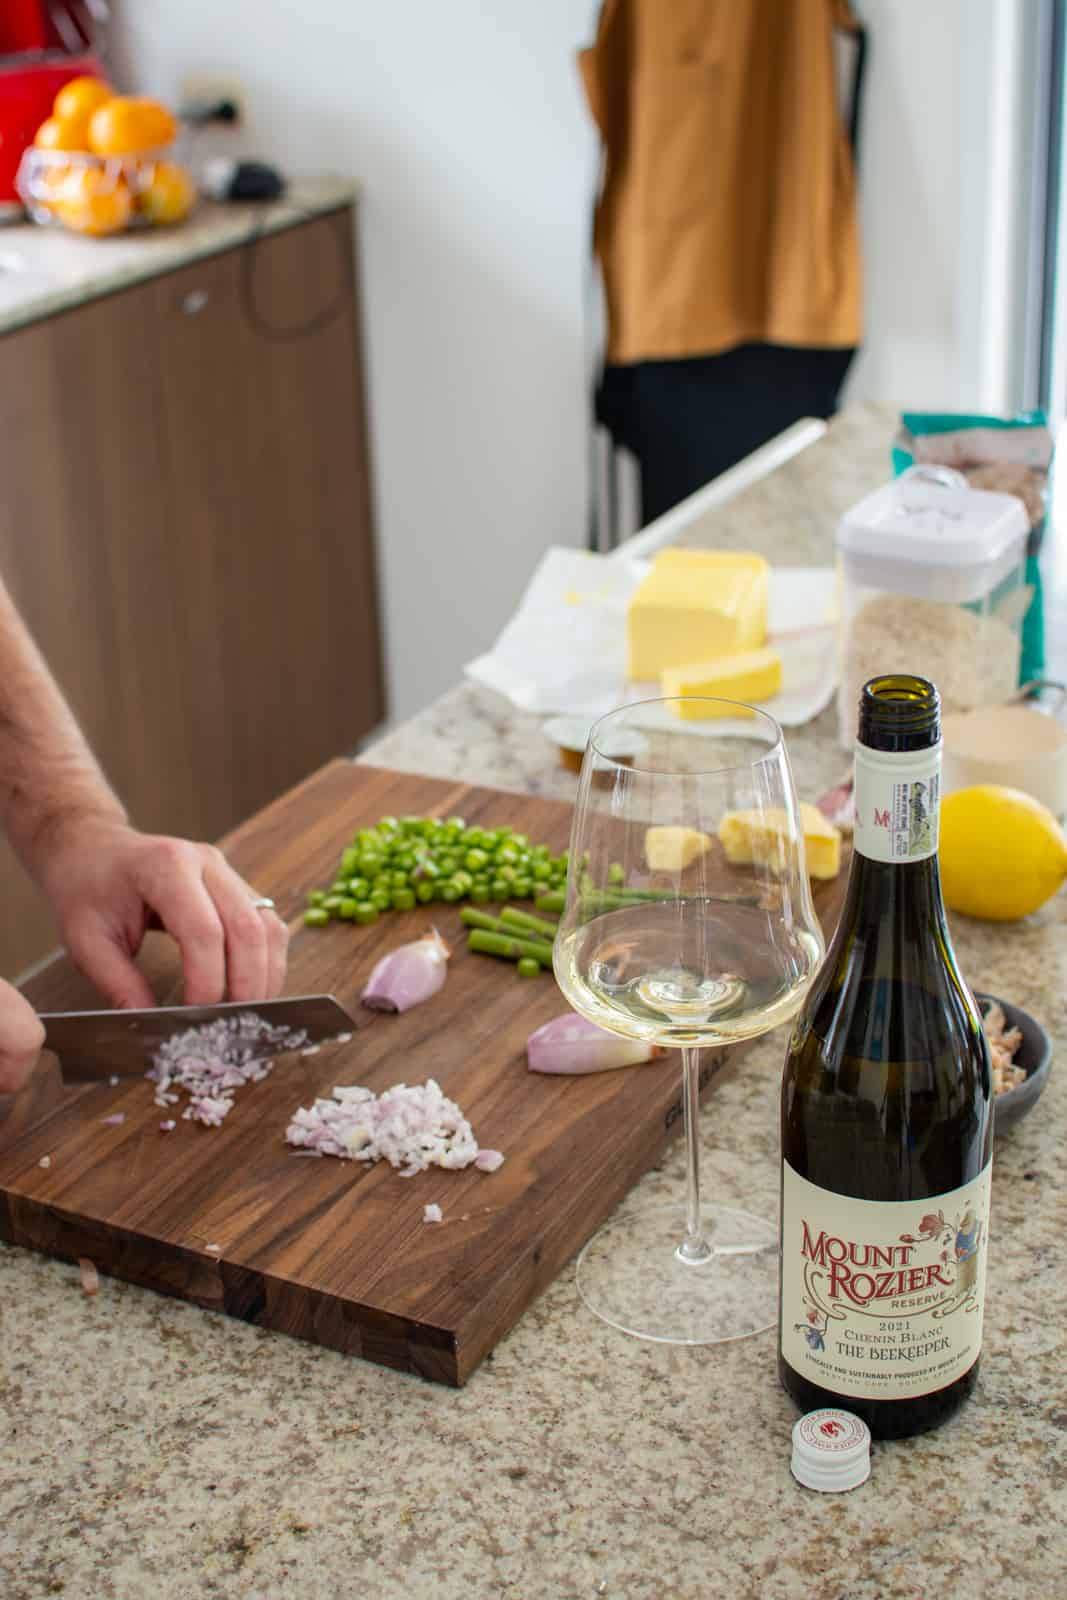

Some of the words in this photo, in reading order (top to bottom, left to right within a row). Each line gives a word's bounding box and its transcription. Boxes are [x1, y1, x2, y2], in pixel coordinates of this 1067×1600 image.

[801, 1219, 915, 1267] MOUNT
[827, 1263, 955, 1306] ROZIER
[891, 1291, 946, 1308] RESERVE
[844, 1329, 896, 1344] CHENIN
[901, 1326, 944, 1343] BLANC
[879, 1321, 911, 1332] 2021
[835, 1341, 865, 1359] THE
[869, 1336, 952, 1361] BEEKEEPER
